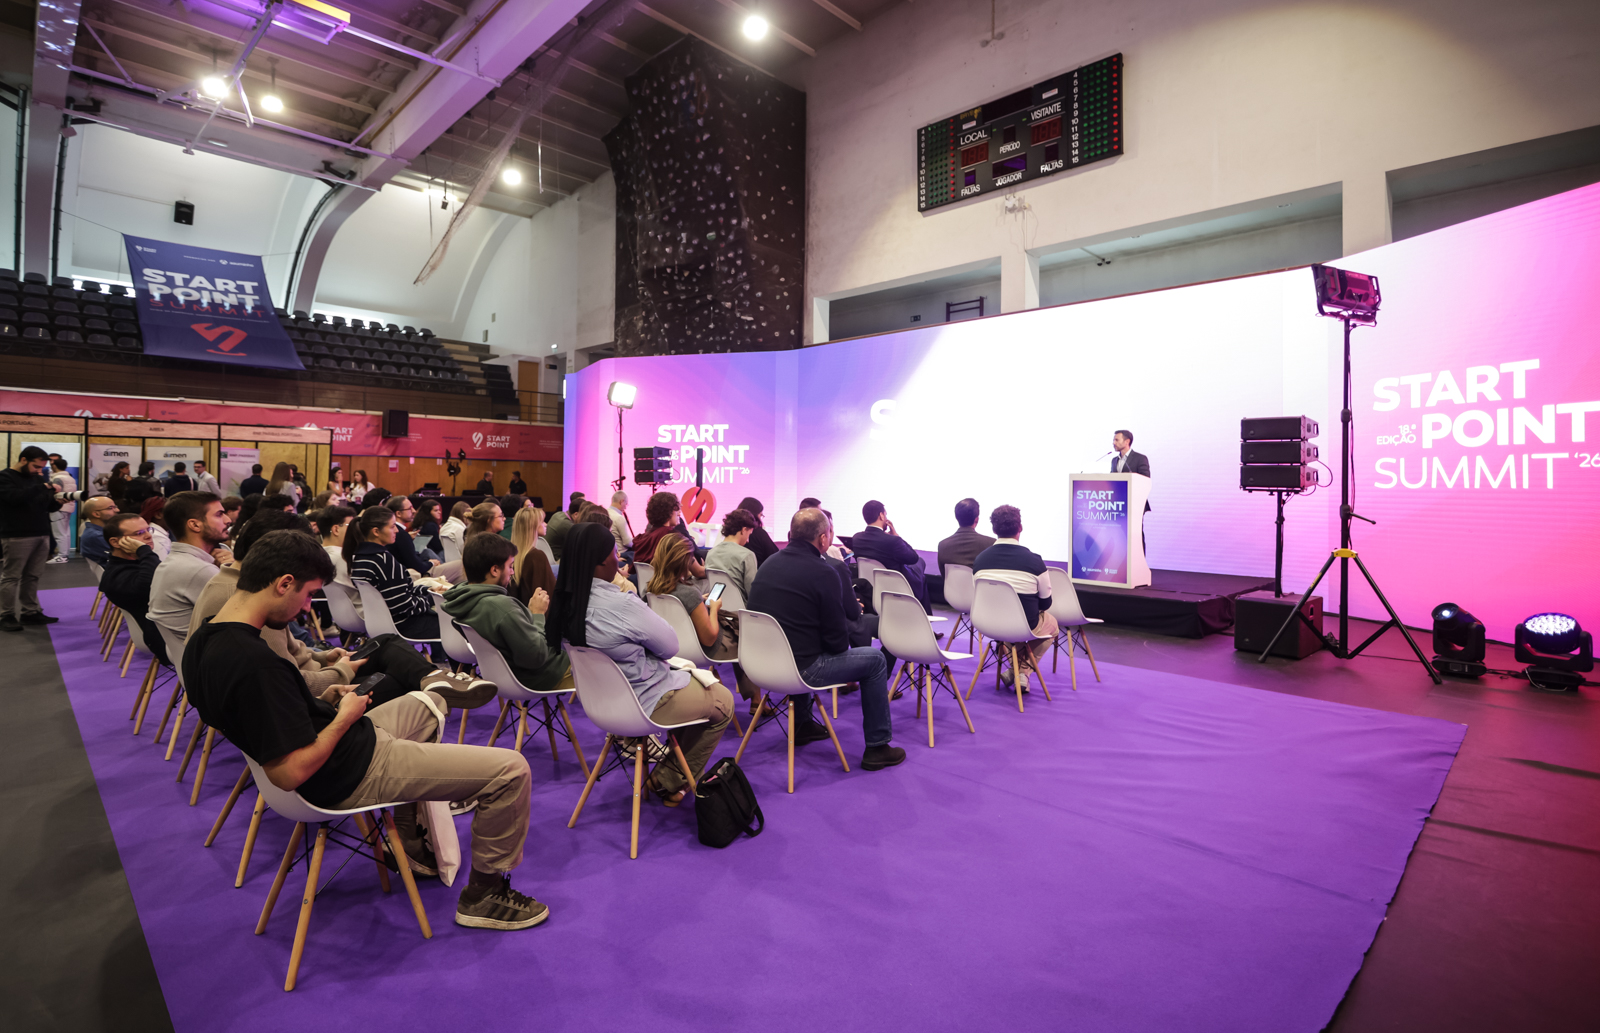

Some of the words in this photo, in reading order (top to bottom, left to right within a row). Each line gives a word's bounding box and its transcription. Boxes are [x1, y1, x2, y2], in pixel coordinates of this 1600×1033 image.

[1030, 102, 1062, 121] VISITANTE
[960, 130, 988, 146] LOCAL
[999, 141, 1021, 154] PERIODO
[1040, 159, 1064, 174] FALTAS
[995, 172, 1023, 187] JUGADOR
[961, 184, 980, 197] FALTAS
[142, 267, 259, 294] START
[147, 282, 260, 307] POINT
[149, 298, 265, 318] SUMMIT
[1372, 358, 1540, 412] START
[657, 424, 730, 443] START
[1421, 401, 1600, 449] POINT
[1376, 433, 1417, 447] EDIÇÃO
[680, 445, 750, 464] POINT
[662, 466, 739, 484] UMMIT
[1373, 453, 1570, 489] SUMMIT
[1076, 490, 1115, 500] START
[1088, 500, 1125, 511] POINT
[1076, 510, 1119, 521] SUMMIT
